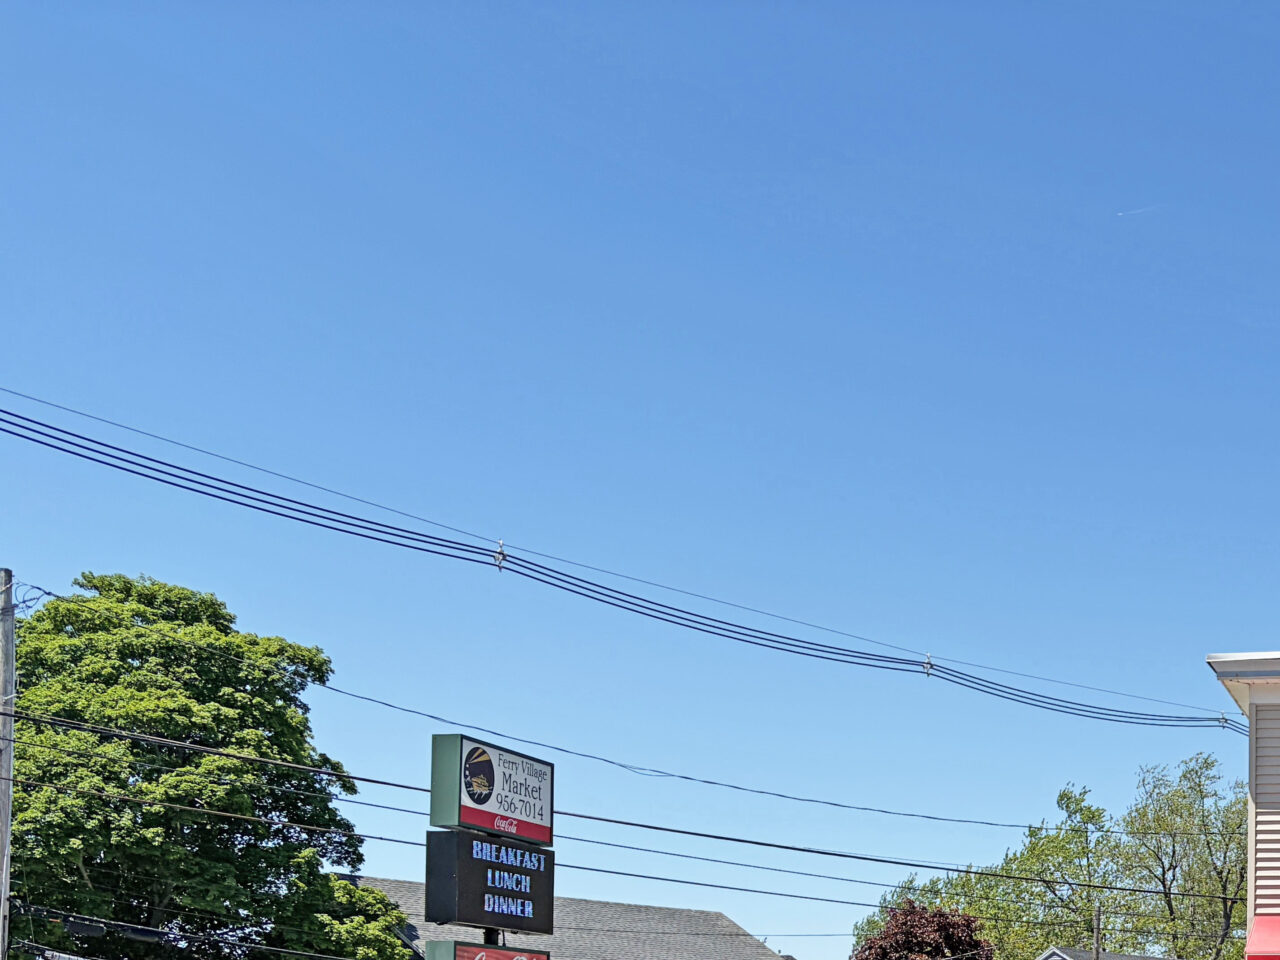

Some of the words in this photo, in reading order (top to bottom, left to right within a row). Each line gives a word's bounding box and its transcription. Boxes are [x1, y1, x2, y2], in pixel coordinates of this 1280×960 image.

[498, 753, 520, 775] Ferry
[522, 760, 548, 783] Village
[502, 771, 542, 801] Market
[496, 793, 544, 821] 956-7014
[472, 840, 546, 872] BREAKFAST
[487, 868, 531, 893] LUNCH
[484, 893, 534, 918] DINNER
